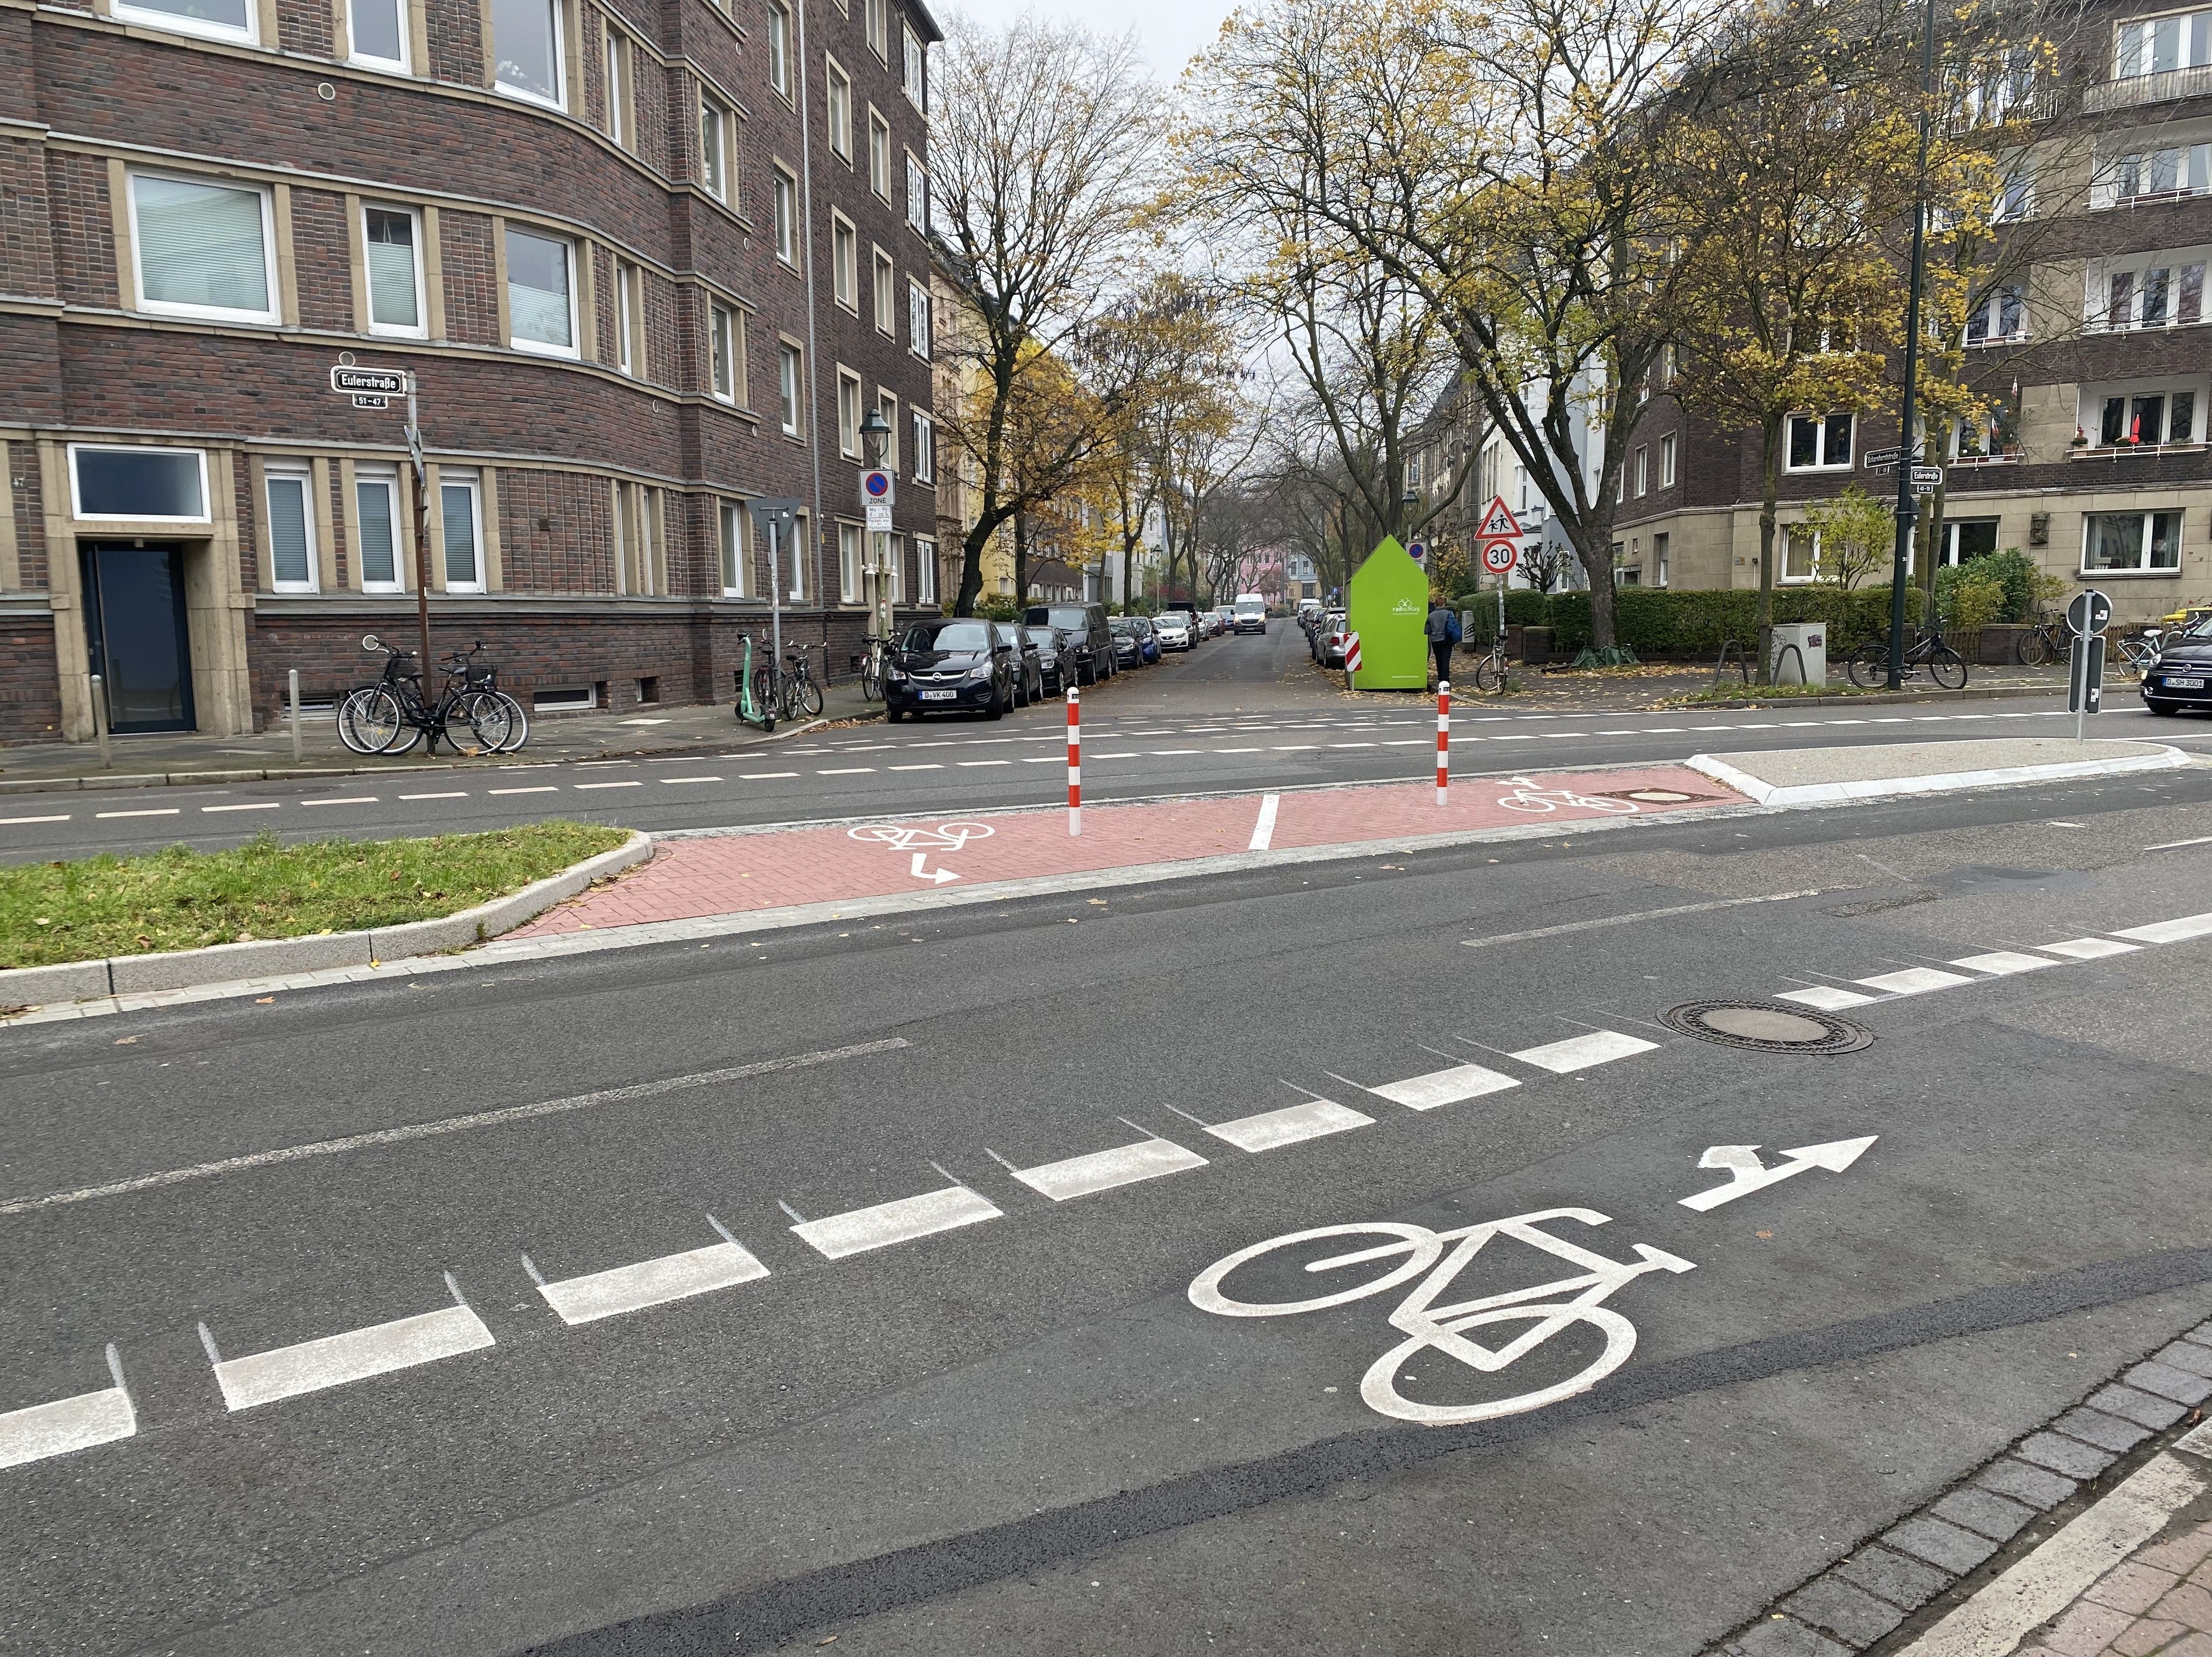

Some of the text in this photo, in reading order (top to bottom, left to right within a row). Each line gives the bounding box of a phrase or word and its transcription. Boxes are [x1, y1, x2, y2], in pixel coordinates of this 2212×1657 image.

[341, 374, 396, 390] Eulerstraße
[1914, 471, 1938, 481] Eulerstraße
[1490, 548, 1509, 565] 30
